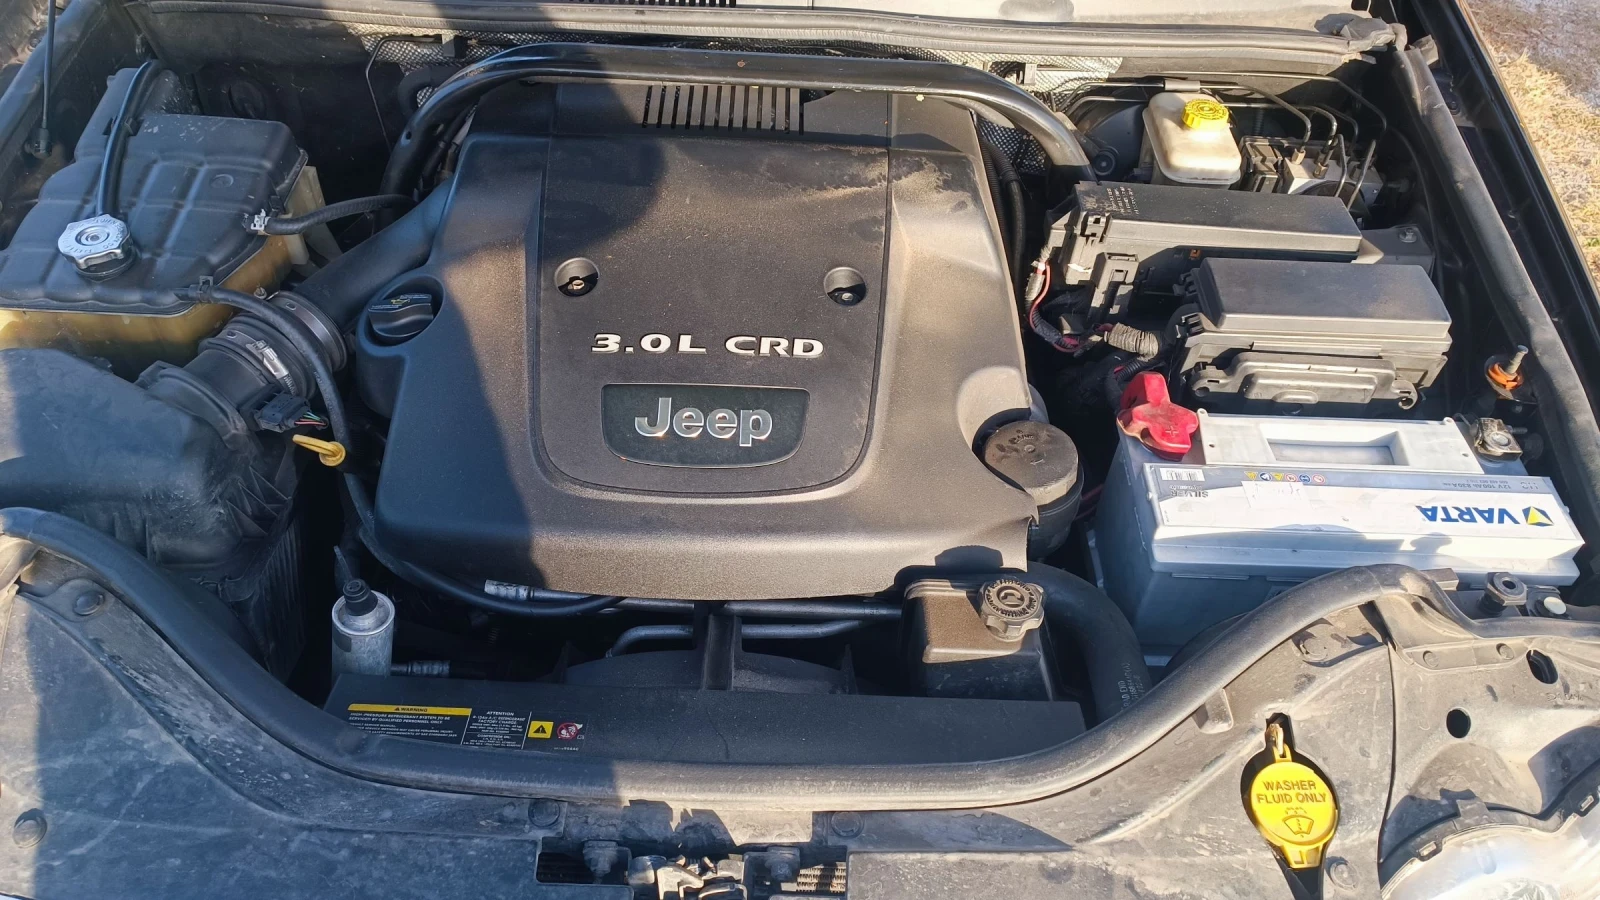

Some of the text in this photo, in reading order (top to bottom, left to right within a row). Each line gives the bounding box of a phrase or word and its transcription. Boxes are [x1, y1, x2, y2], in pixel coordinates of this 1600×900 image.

[591, 333, 824, 358] 3.0L CRD
[634, 397, 772, 447] Jeep
[1171, 490, 1209, 498] SILVER
[1415, 505, 1520, 524] VARTA
[1263, 780, 1317, 791] WASHER
[1256, 792, 1327, 804] FLUID ONLY
